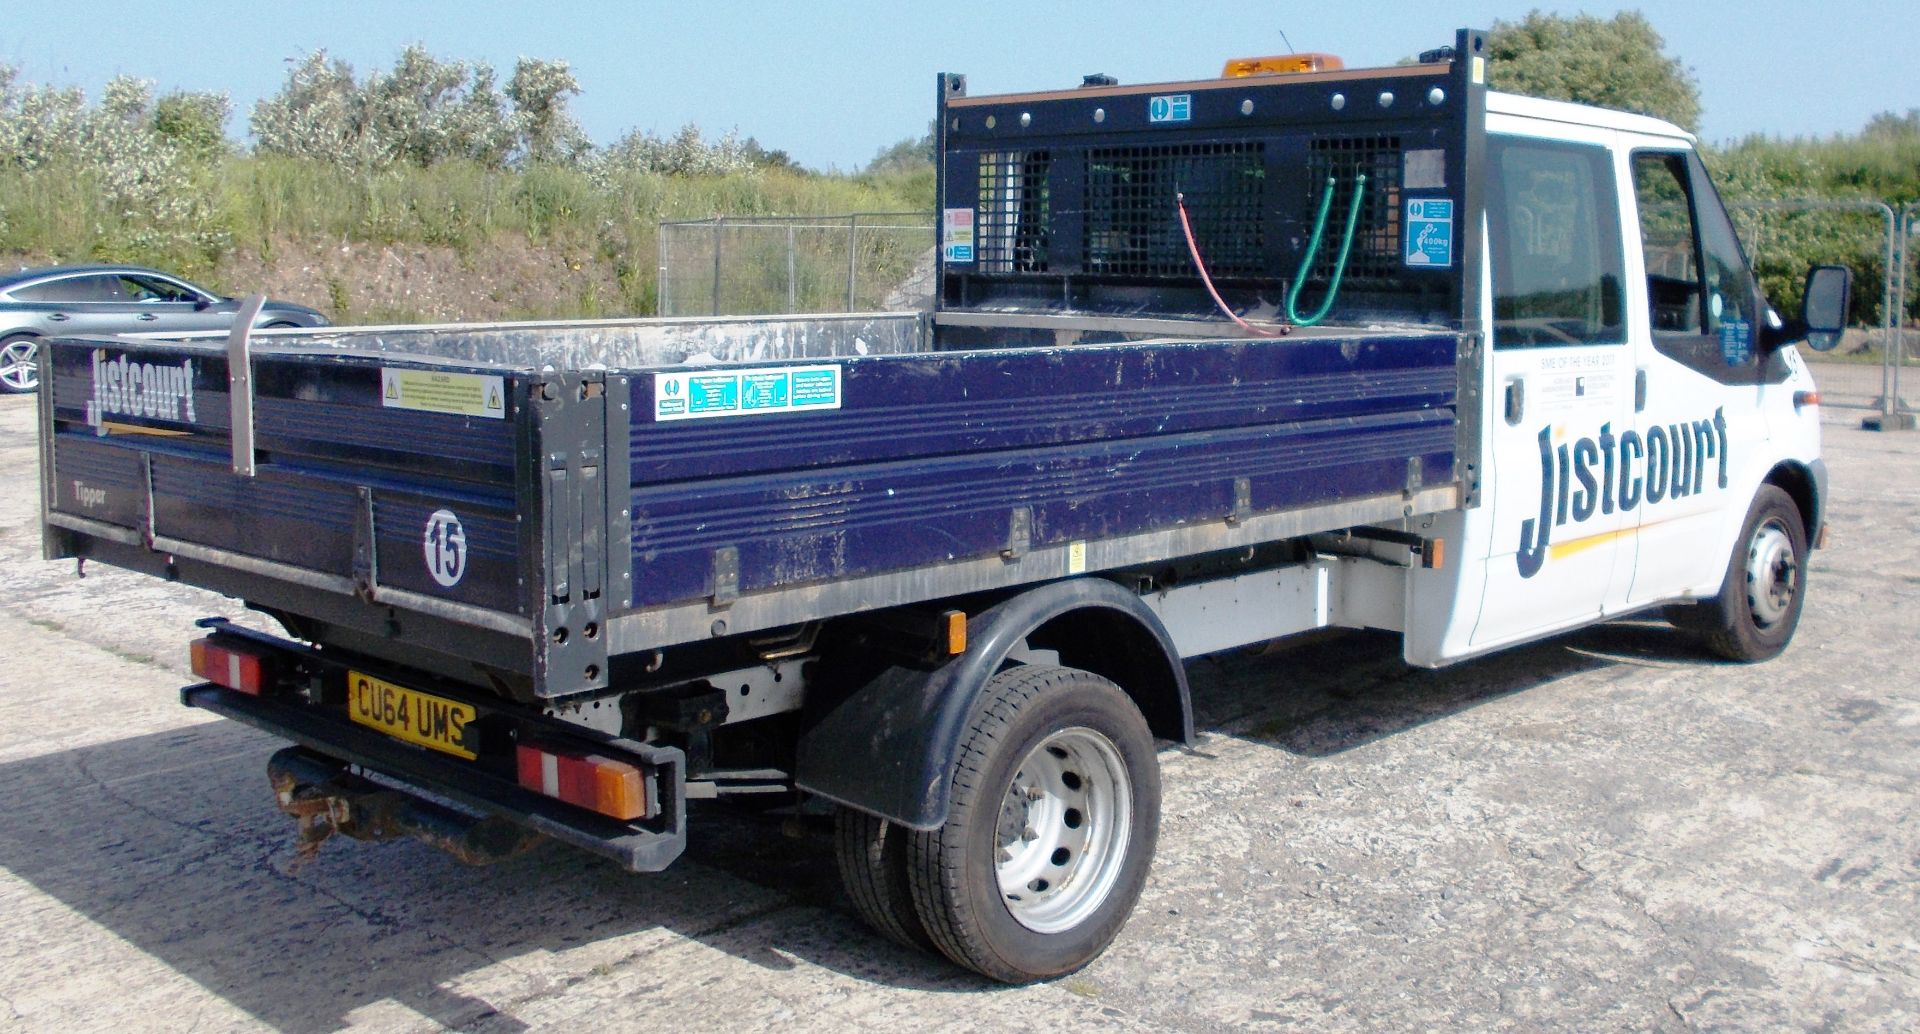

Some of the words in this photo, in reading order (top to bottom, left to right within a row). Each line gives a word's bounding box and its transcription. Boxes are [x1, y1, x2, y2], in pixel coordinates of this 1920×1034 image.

[88, 349, 196, 437] Jistcourt
[1541, 357, 1556, 370] SME
[1558, 356, 1568, 369] OF
[1570, 355, 1581, 368] THE
[1583, 354, 1600, 368] YEAR
[74, 480, 106, 507] Tipper
[1516, 404, 1728, 578] Jistcourt
[430, 520, 460, 577] 15
[358, 679, 410, 731] CU64
[416, 697, 465, 747] UMS
